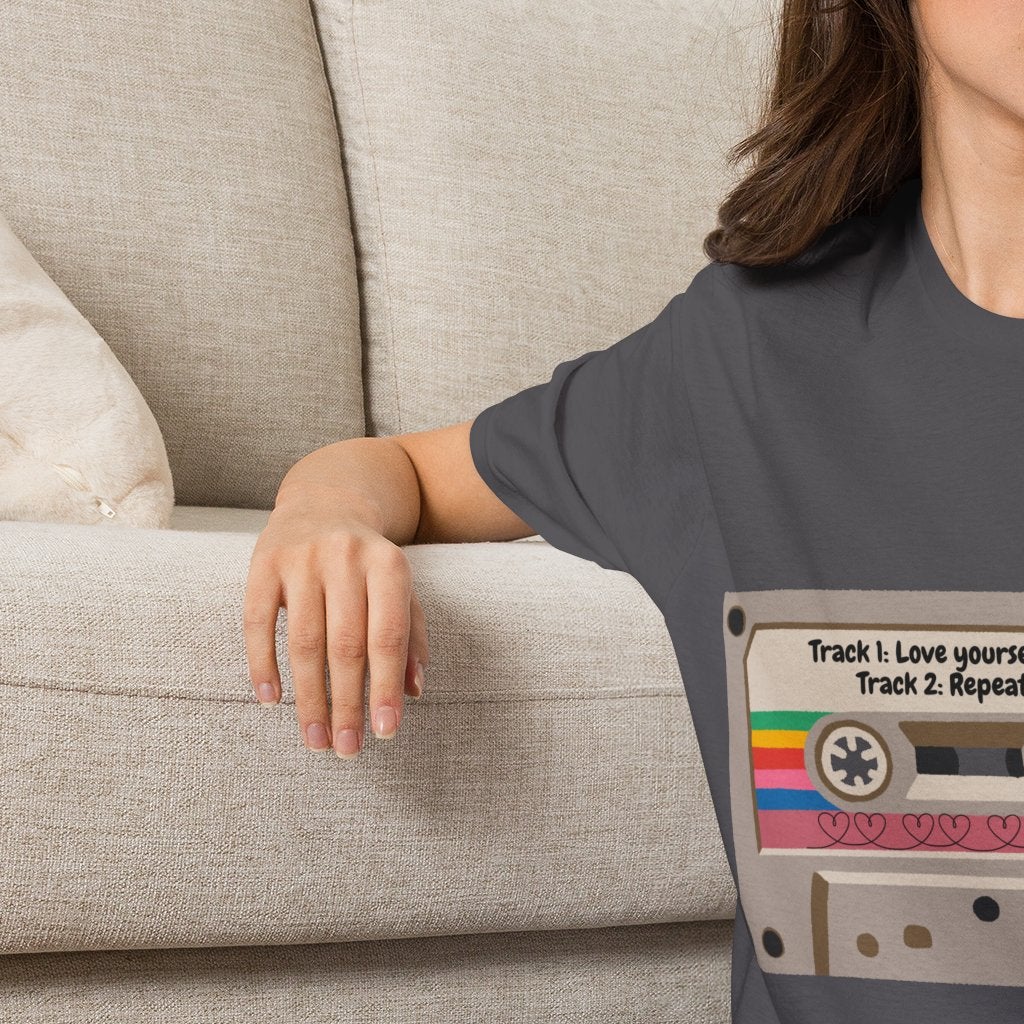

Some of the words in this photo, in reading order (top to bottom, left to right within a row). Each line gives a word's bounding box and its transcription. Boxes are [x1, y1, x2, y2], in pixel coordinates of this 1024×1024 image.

[808, 639, 871, 663] Track
[875, 640, 890, 664] 1:
[895, 640, 948, 665] Love
[855, 671, 918, 696] Track
[923, 672, 944, 696] 2:
